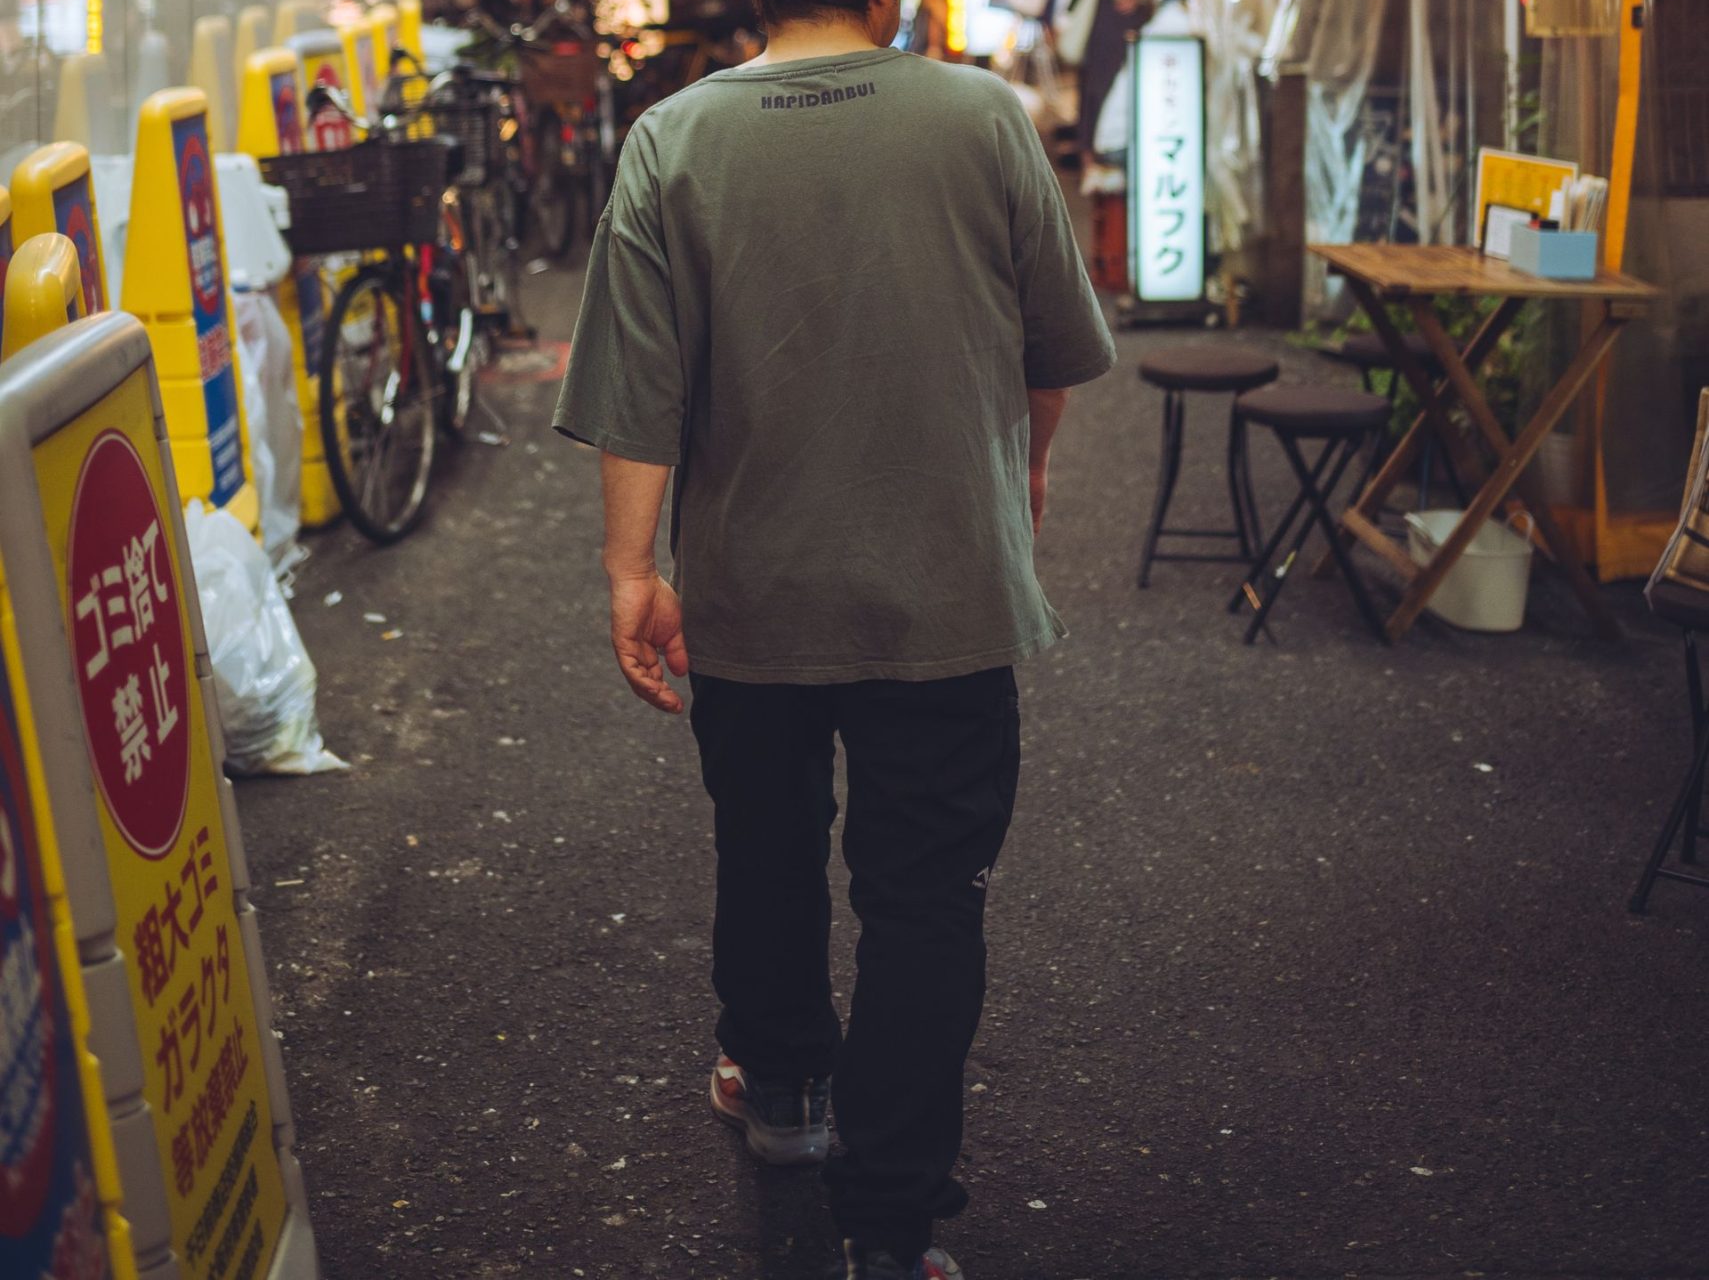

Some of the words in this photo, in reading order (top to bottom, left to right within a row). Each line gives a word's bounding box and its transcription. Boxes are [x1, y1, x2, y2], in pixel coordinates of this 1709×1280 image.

[761, 82, 876, 109] HAPIDANBUI
[1154, 135, 1187, 276] マルフク
[76, 519, 168, 681] ゴミ捨て
[111, 643, 179, 785] 禁止
[133, 825, 218, 1008] 粗大ゴミ
[156, 923, 230, 1114] ガラクタ
